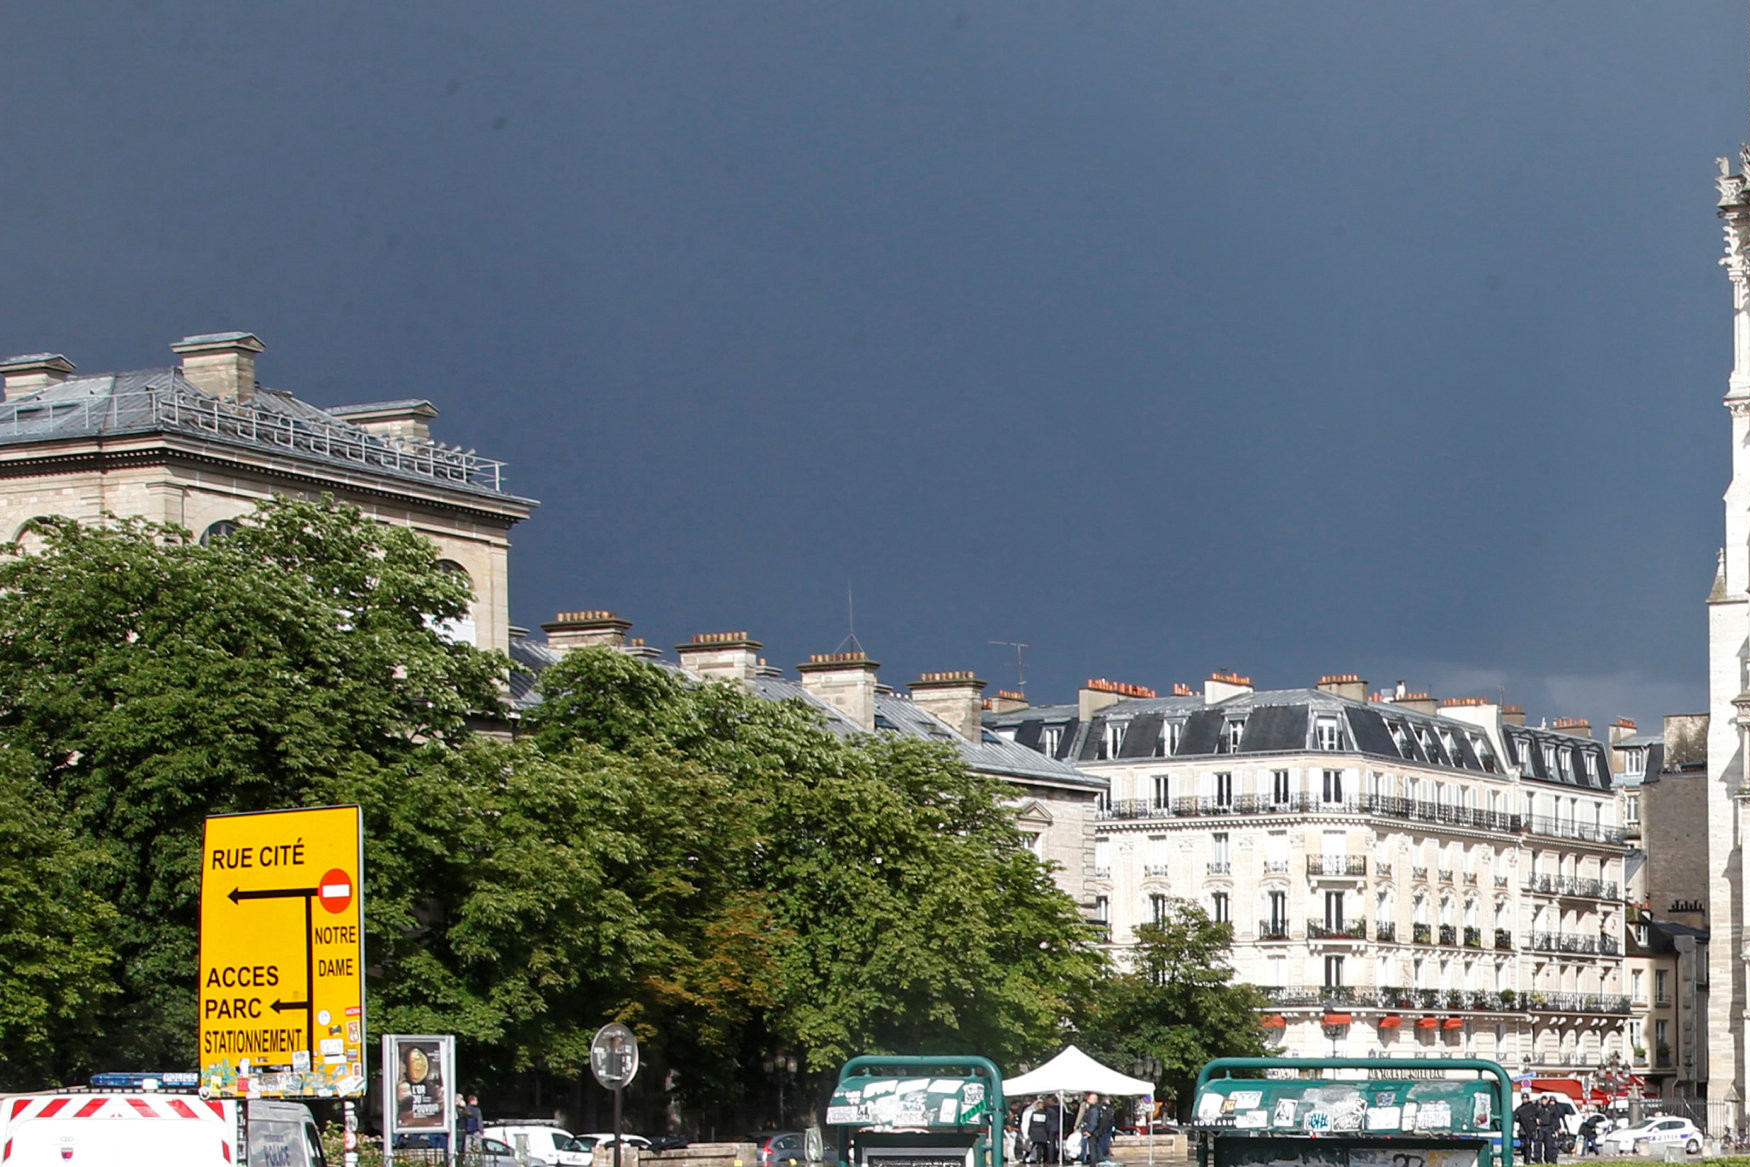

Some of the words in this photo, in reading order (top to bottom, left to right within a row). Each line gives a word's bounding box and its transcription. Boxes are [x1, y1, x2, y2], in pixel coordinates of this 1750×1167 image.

[212, 847, 252, 870] RUE
[259, 837, 305, 867] CITÉ
[315, 925, 356, 945] NOTRE
[206, 965, 279, 988] ACCES
[318, 958, 353, 977] DAME
[205, 997, 262, 1019] PARC
[204, 1028, 302, 1054] STATIONNEMENT
[264, 1145, 291, 1167] POLICE
